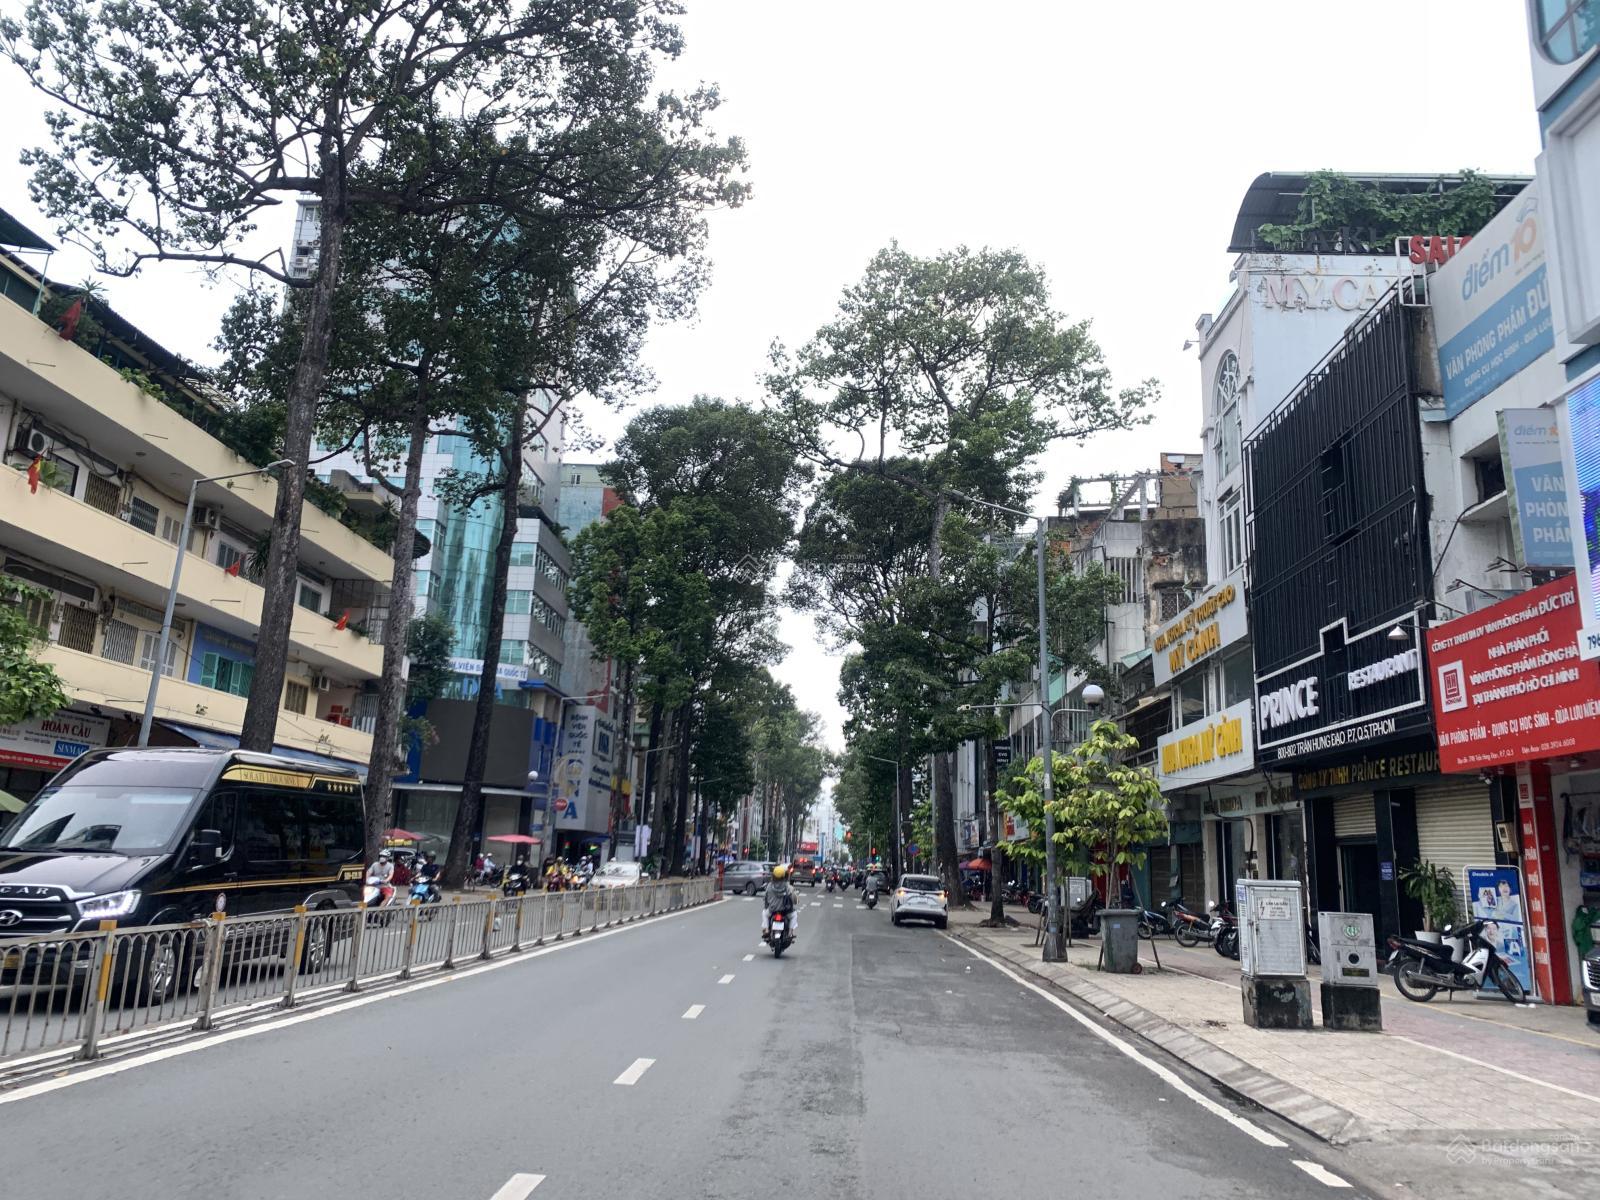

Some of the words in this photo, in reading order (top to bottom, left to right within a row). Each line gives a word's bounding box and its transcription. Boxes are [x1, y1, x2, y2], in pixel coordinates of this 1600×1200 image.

[1462, 243, 1509, 301] điểm
[1445, 356, 1465, 380] VĂN
[1465, 329, 1496, 366] PHÒNG
[1497, 304, 1527, 341] PHẨM
[1539, 594, 1560, 615] ĐỨC
[1560, 586, 1575, 607] TRÍ
[1488, 641, 1506, 660] NHÀ
[1506, 636, 1529, 653] PHÂN
[1529, 626, 1550, 646] PHỐI
[1347, 648, 1421, 691] RESTAURANT
[1469, 671, 1484, 686] VĂN
[1483, 663, 1513, 683] PHÒNG
[1513, 653, 1538, 674] PHẨM
[1537, 648, 1566, 670] HỒNG
[1565, 641, 1580, 660] HÀ
[1260, 676, 1320, 731] PRINCE
[1483, 685, 1509, 703] THÀNH
[1508, 676, 1526, 696] PHỐ
[1526, 675, 1541, 691] HỒ
[41, 718, 70, 735] HOÀN
[71, 722, 92, 738] CẦU
[1450, 727, 1469, 744] PHÒNG
[1469, 720, 1487, 741] PHẨM
[1492, 721, 1509, 740] DỤNG
[1510, 720, 1519, 736] CỤ
[1519, 716, 1534, 734] HỌC
[1277, 745, 1297, 760] 800-802
